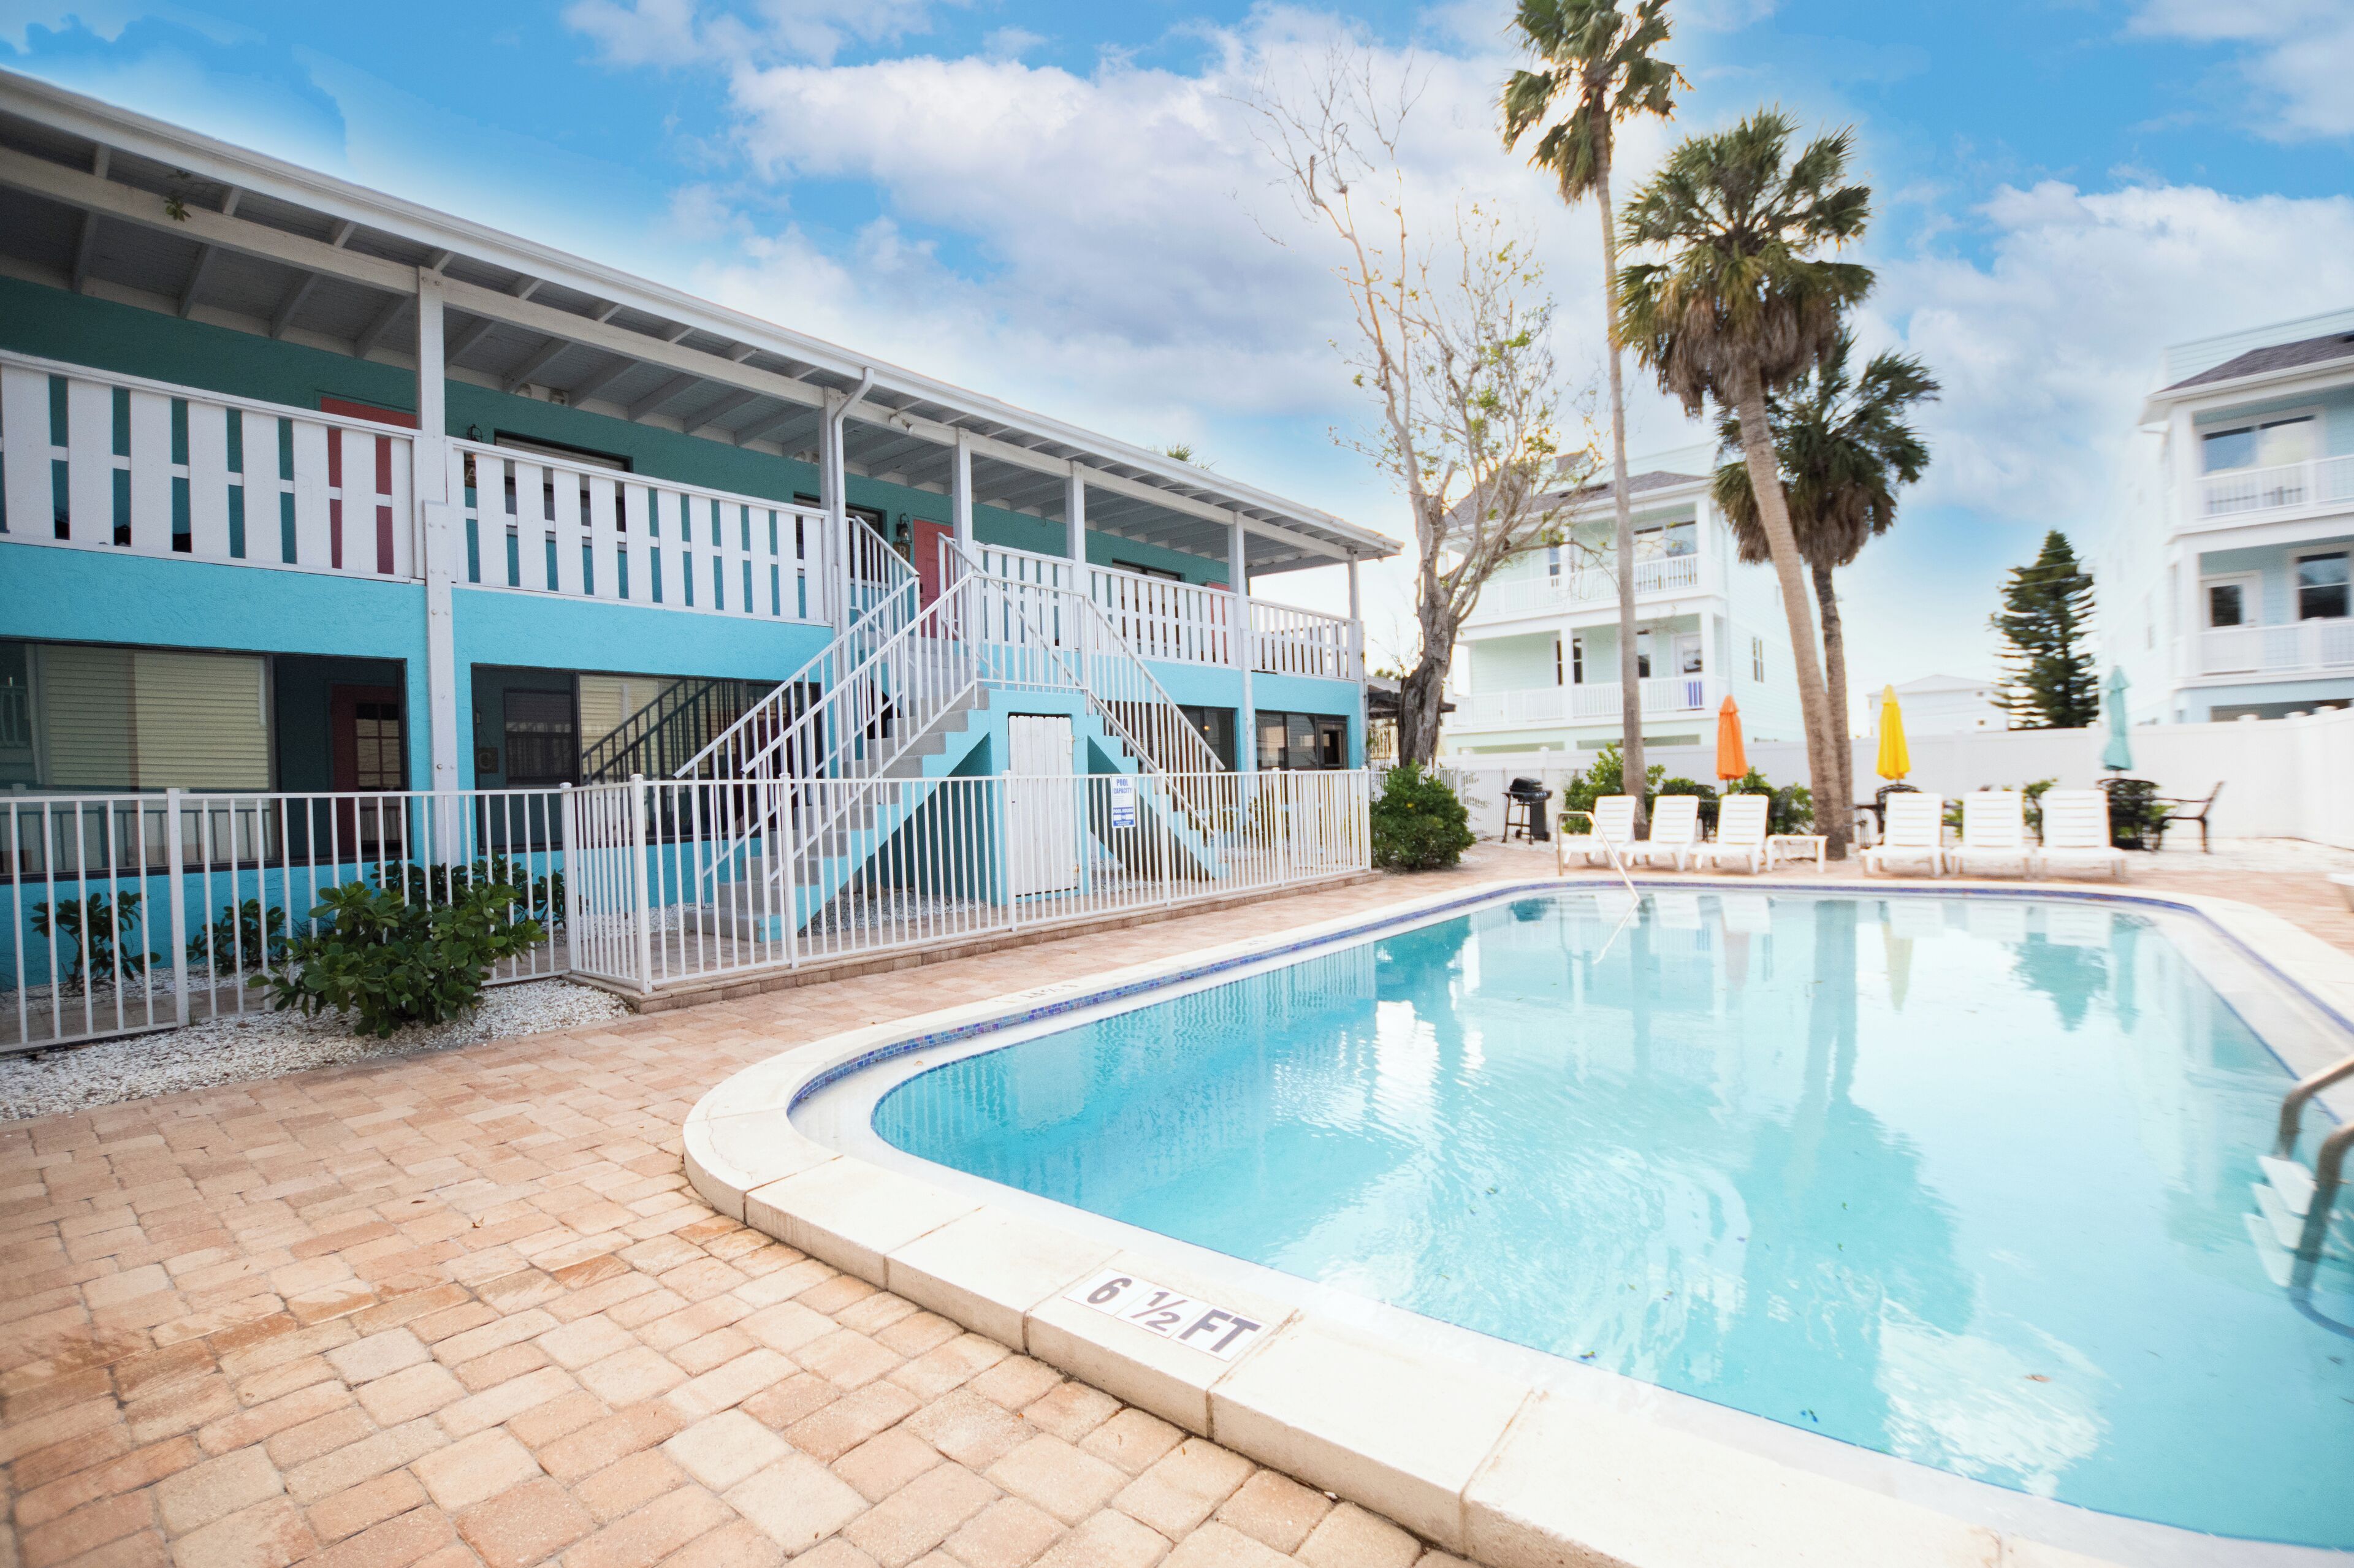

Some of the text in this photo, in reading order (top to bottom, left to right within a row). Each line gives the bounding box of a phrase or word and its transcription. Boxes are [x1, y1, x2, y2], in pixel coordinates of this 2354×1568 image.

[899, 546, 907, 559] B
[1087, 1277, 1133, 1304] 6
[1178, 1309, 1262, 1353] FT
